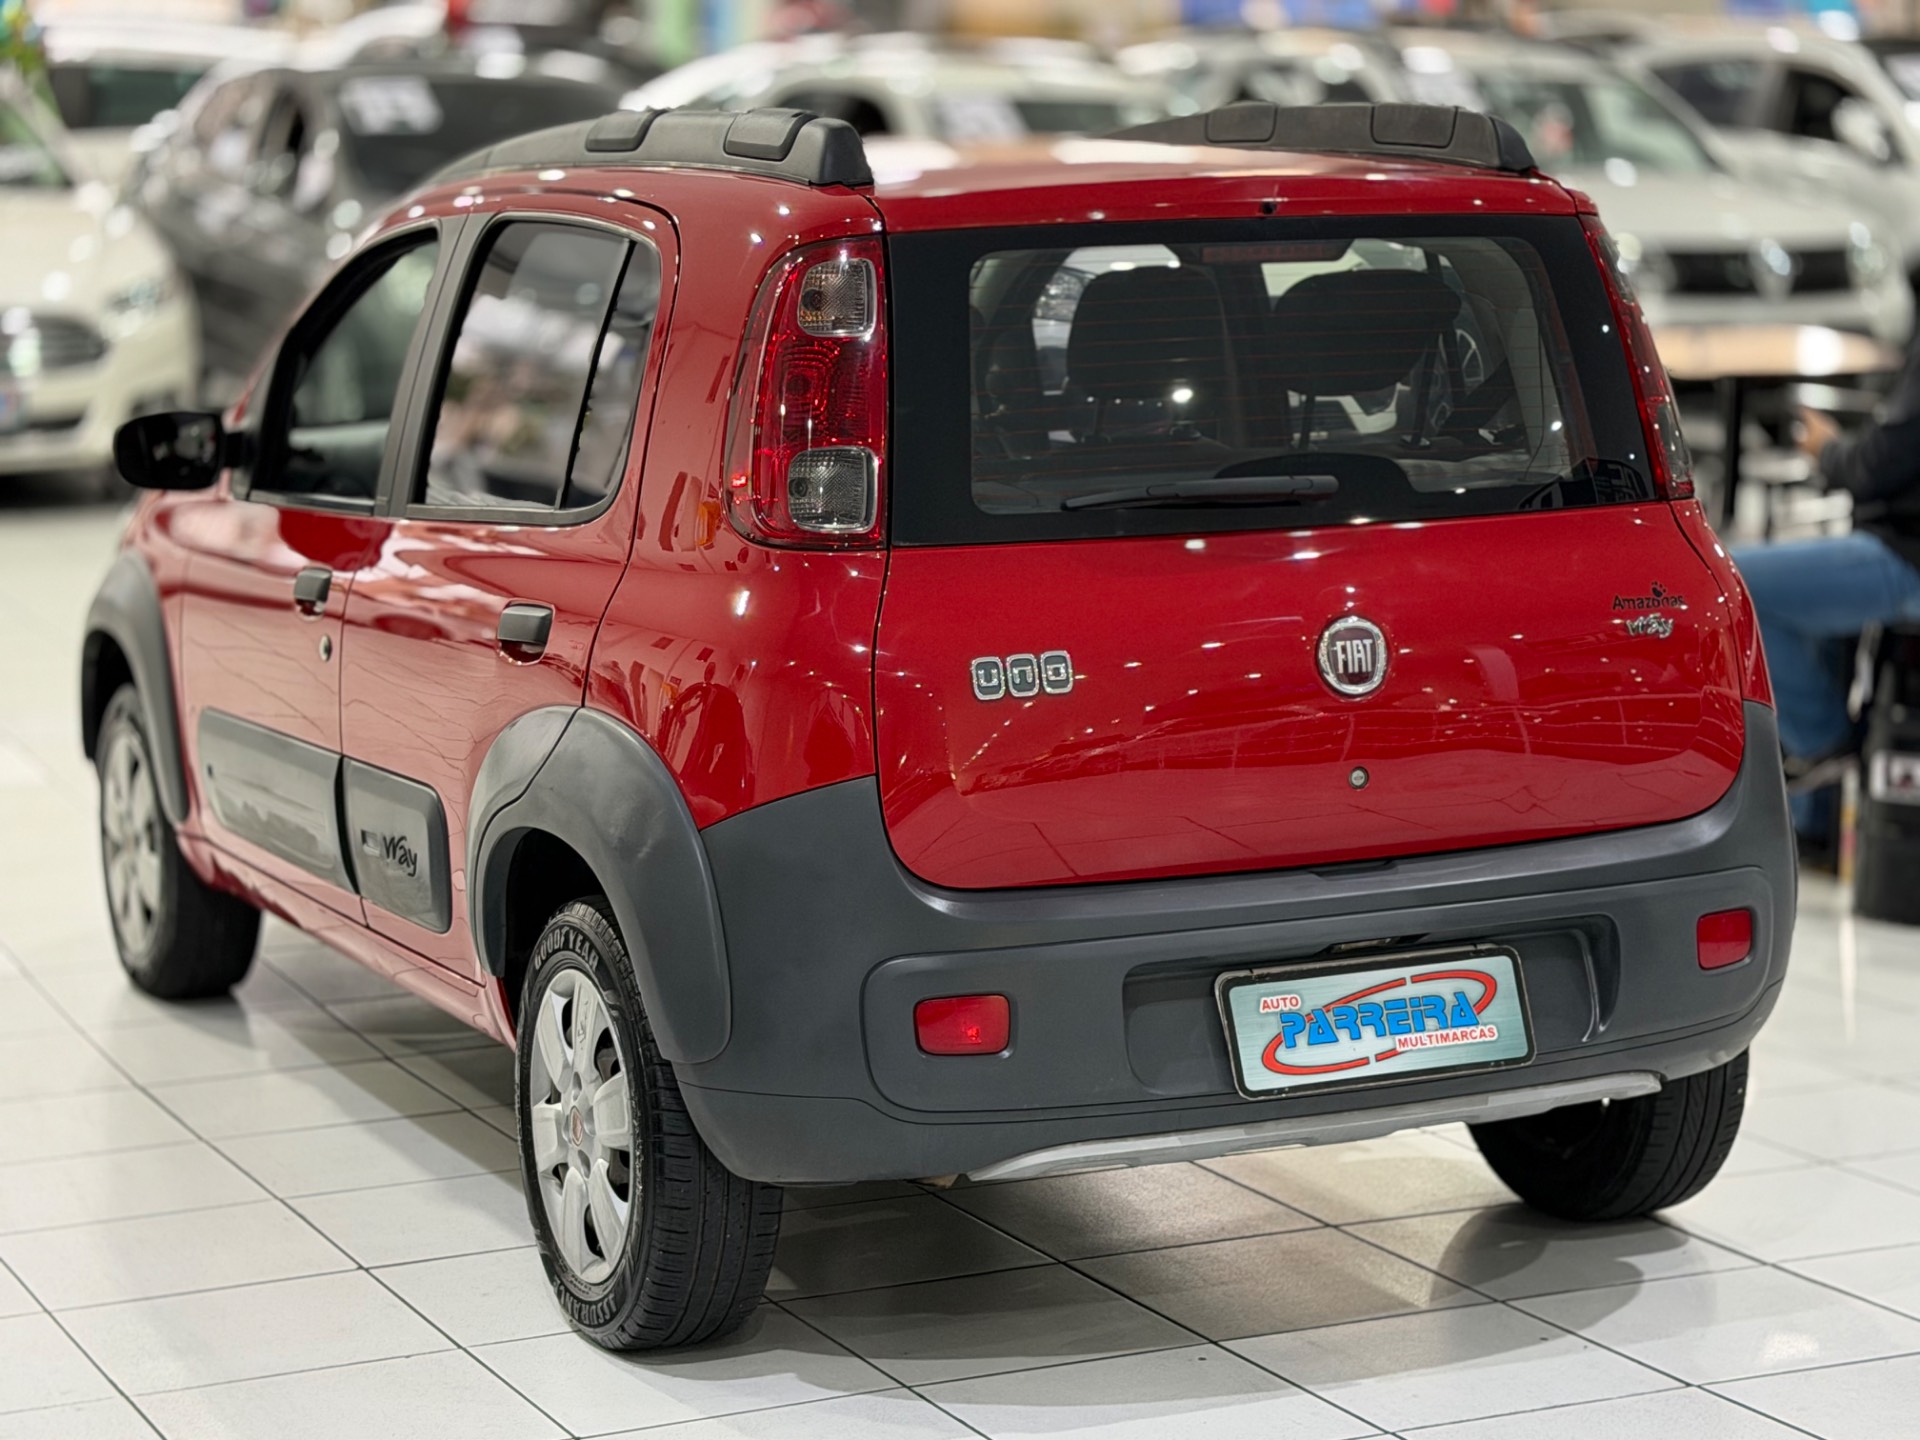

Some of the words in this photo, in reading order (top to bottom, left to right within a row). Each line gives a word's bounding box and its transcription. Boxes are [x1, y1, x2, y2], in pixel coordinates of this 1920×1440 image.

[1612, 594, 1684, 610] Amazonas
[1335, 638, 1373, 674] FIAT
[1261, 996, 1300, 1011] AUTO
[1280, 992, 1479, 1049] PARREIRA
[1397, 1027, 1497, 1049] MULTIMARCAS
